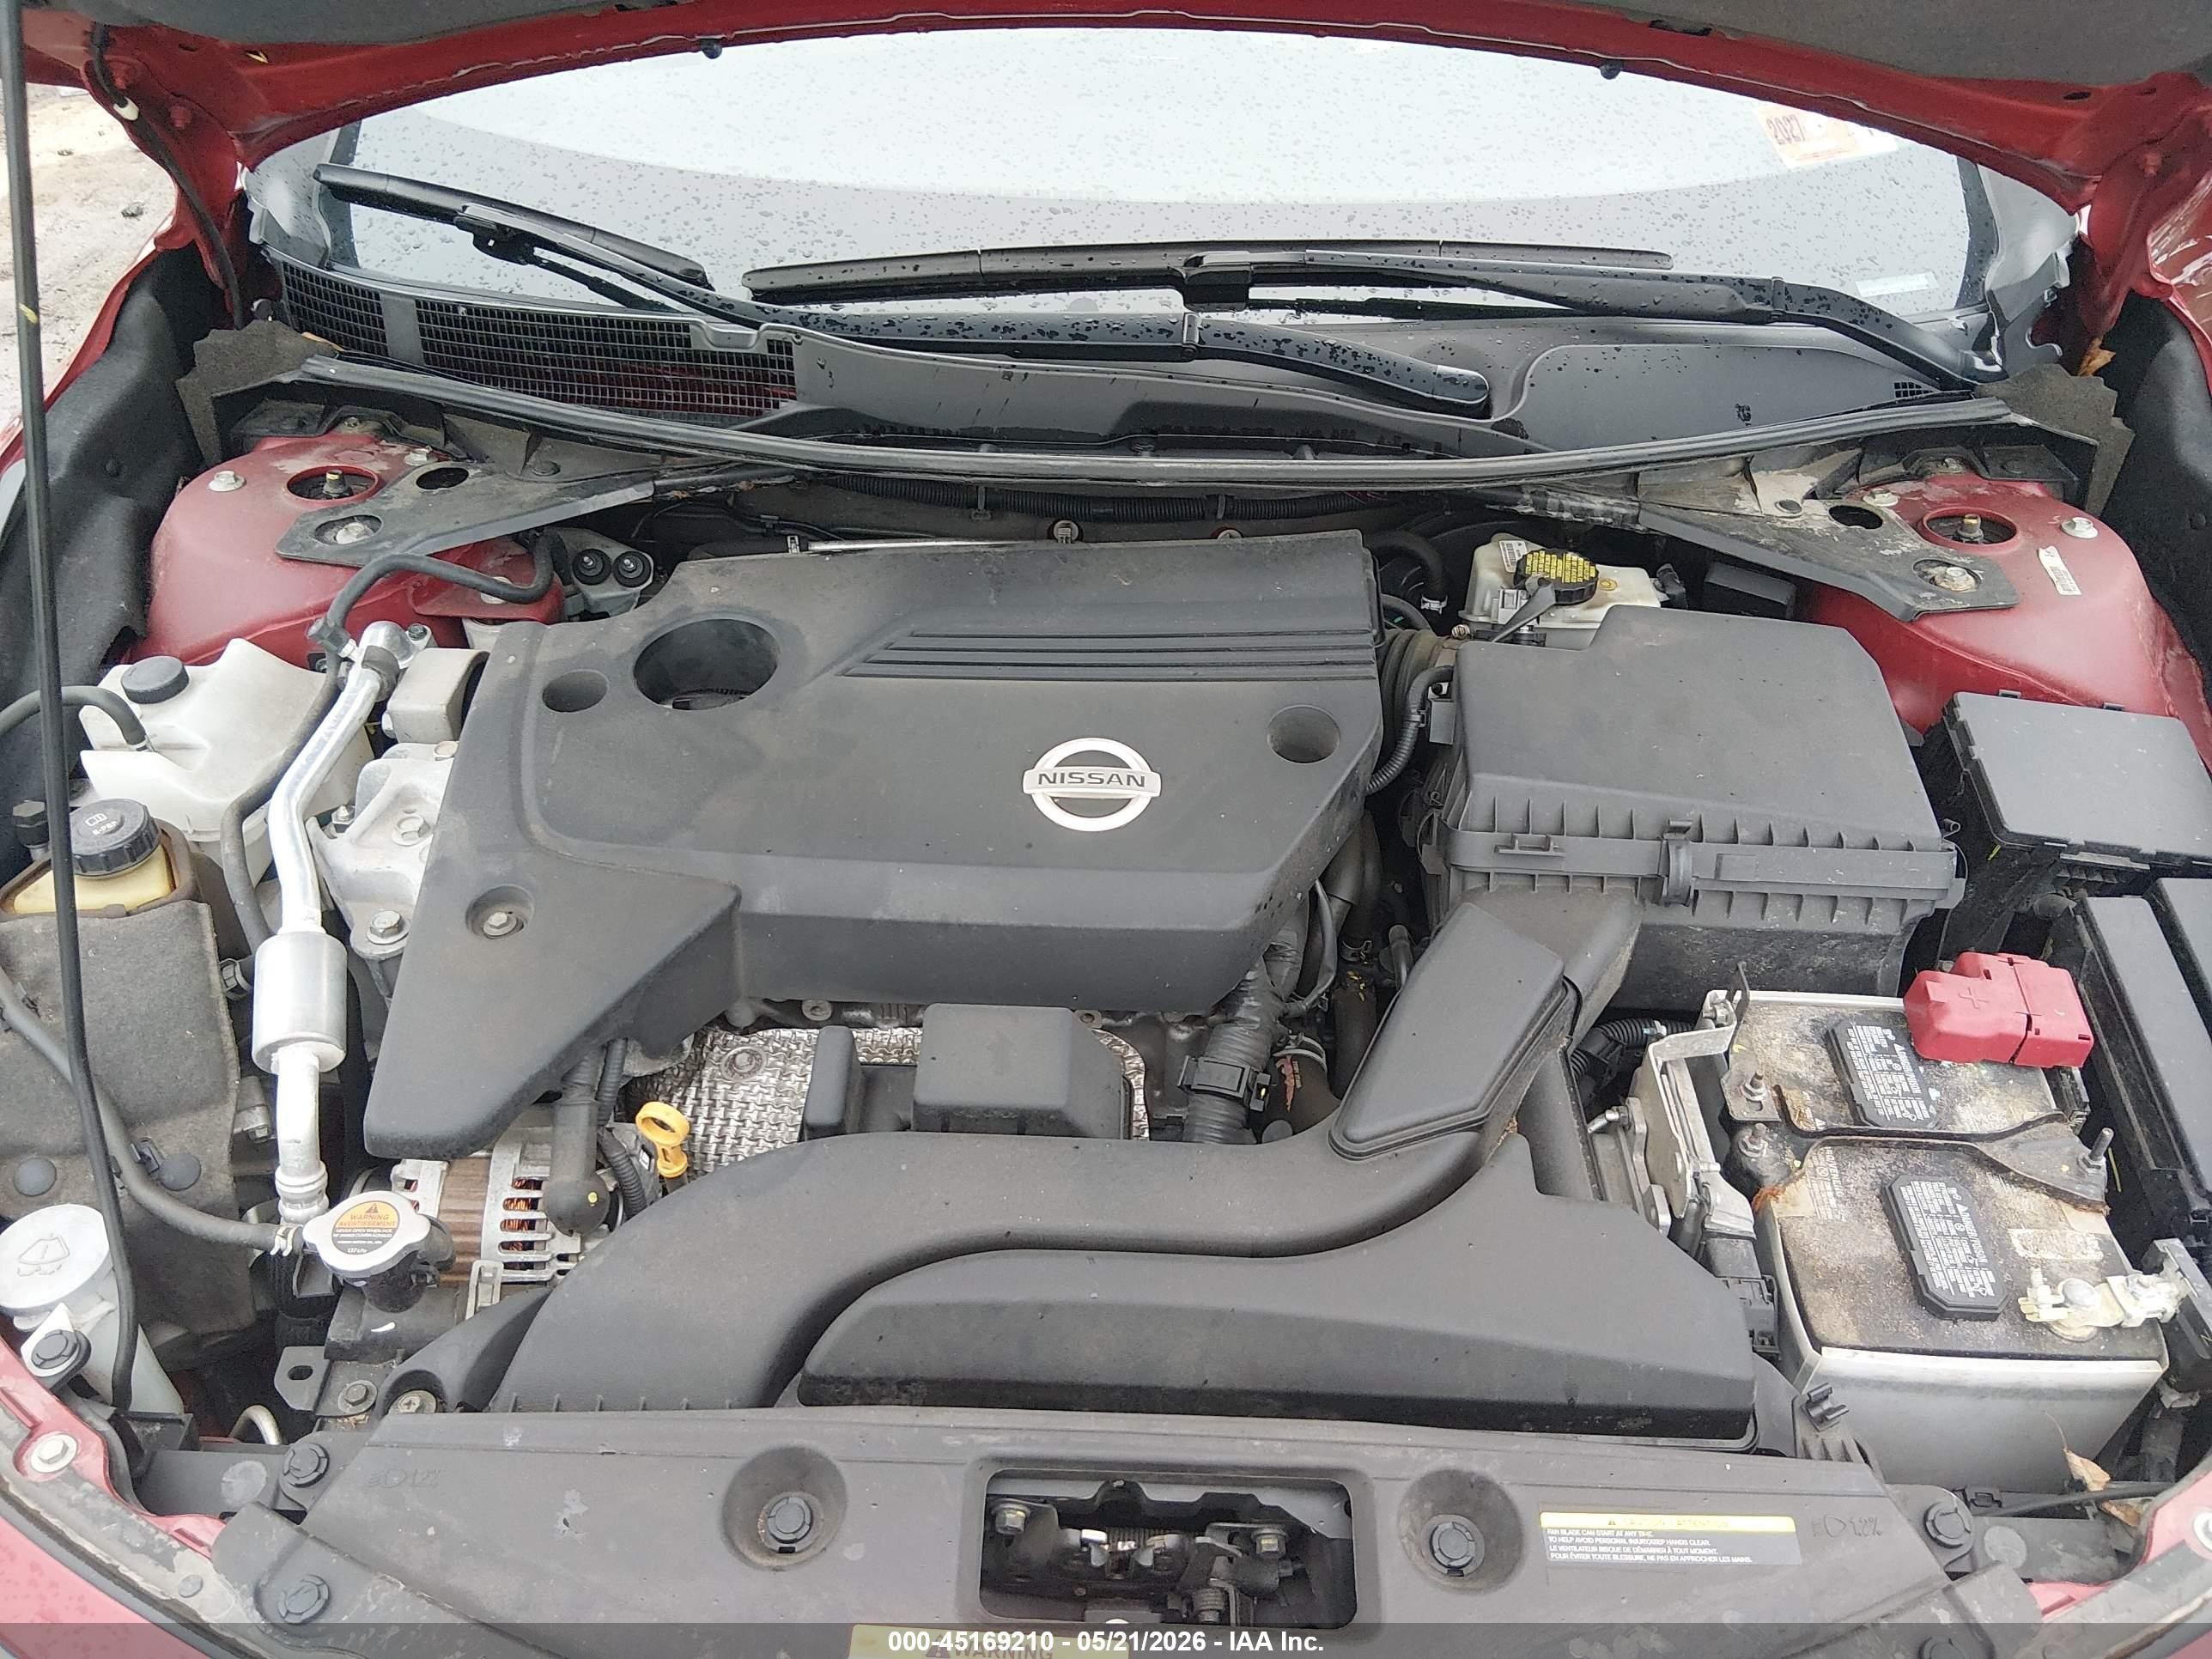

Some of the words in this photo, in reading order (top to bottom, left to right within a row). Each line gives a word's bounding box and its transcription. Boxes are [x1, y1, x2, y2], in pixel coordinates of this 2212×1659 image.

[1765, 114, 1806, 145] 2027
[1038, 772, 1146, 787] NISSAN
[1898, 1052, 1922, 1094] DANGER/POISON
[1960, 1212, 1988, 1262] DANGER/POISON
